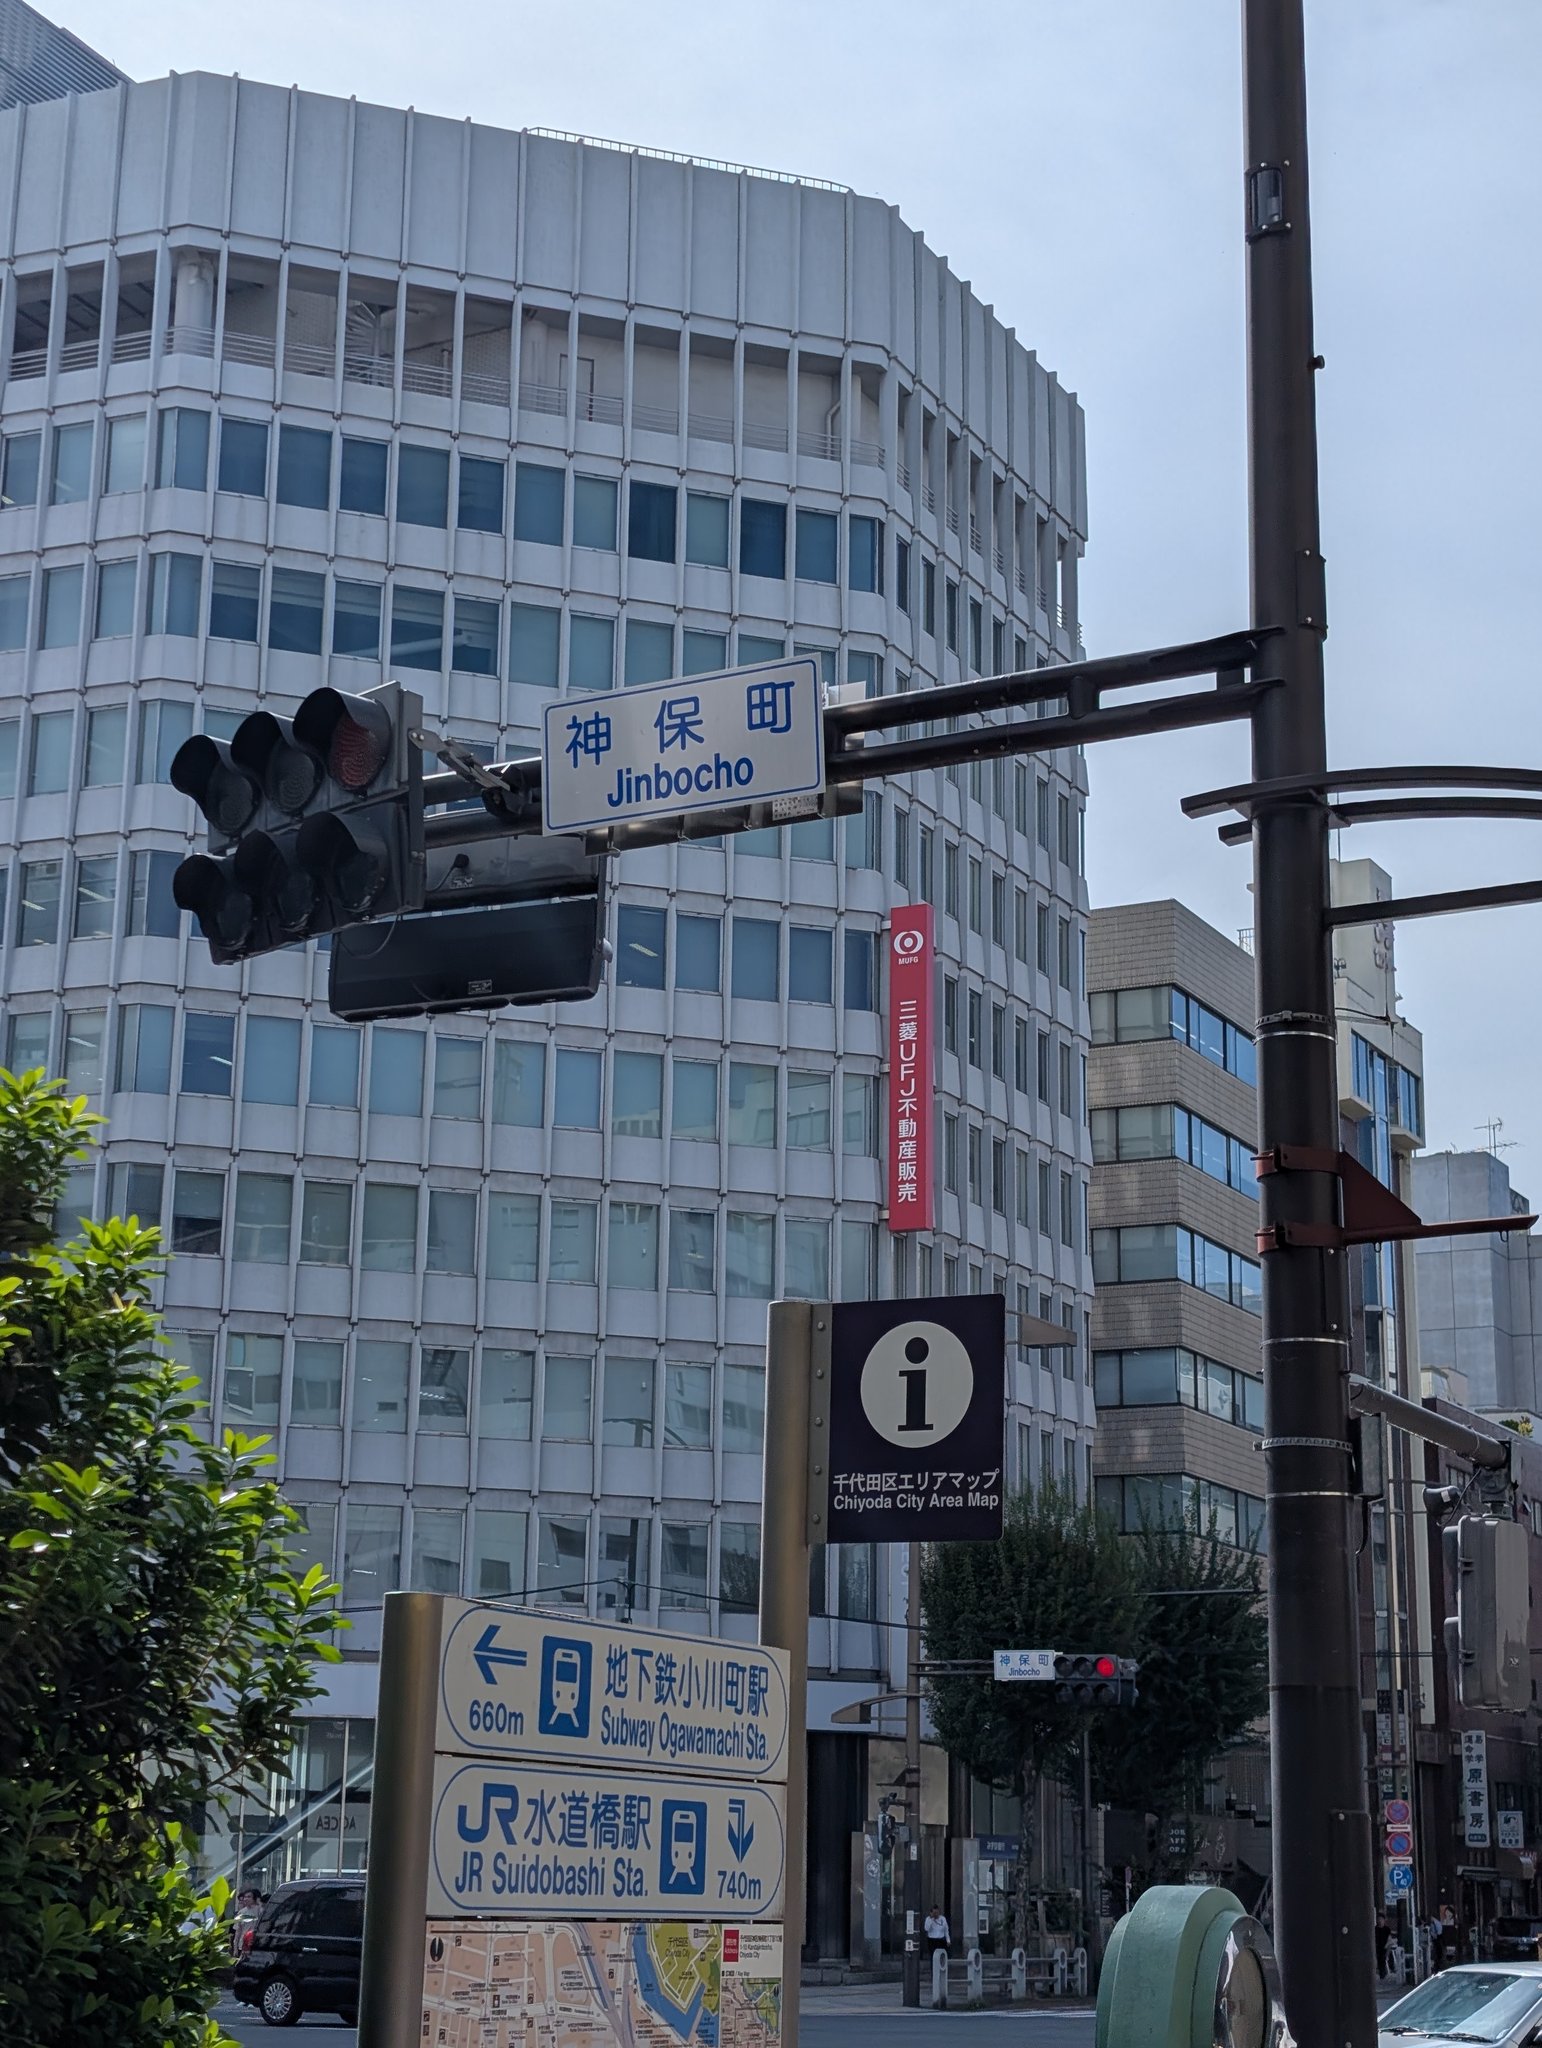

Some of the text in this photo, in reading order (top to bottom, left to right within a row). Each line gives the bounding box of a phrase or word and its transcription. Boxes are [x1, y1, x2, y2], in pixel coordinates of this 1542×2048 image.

[565, 681, 795, 768] 神保町
[608, 754, 753, 807] Jinbocho
[898, 956, 919, 965] MUFG
[897, 1000, 918, 1203] 三菱UFJ不動産販売
[833, 1468, 1000, 1493] 千代田区エリアマップ
[834, 1491, 999, 1513] Chiyoda City Area Map
[999, 1654, 1050, 1667] 神保町
[1008, 1667, 1041, 1677] Jinbocho
[604, 1644, 769, 1718] 地下鉄小川町駅
[469, 1700, 525, 1735] 660m
[601, 1705, 769, 1761] Subway Ogawamachi Sta.
[457, 1782, 652, 1851] JR水道橋駅
[1467, 1768, 1484, 1828] 原書房
[455, 1851, 648, 1897] JR Suidobashi Sta.
[717, 1871, 762, 1900] 740m
[1394, 1870, 1403, 1885] P
